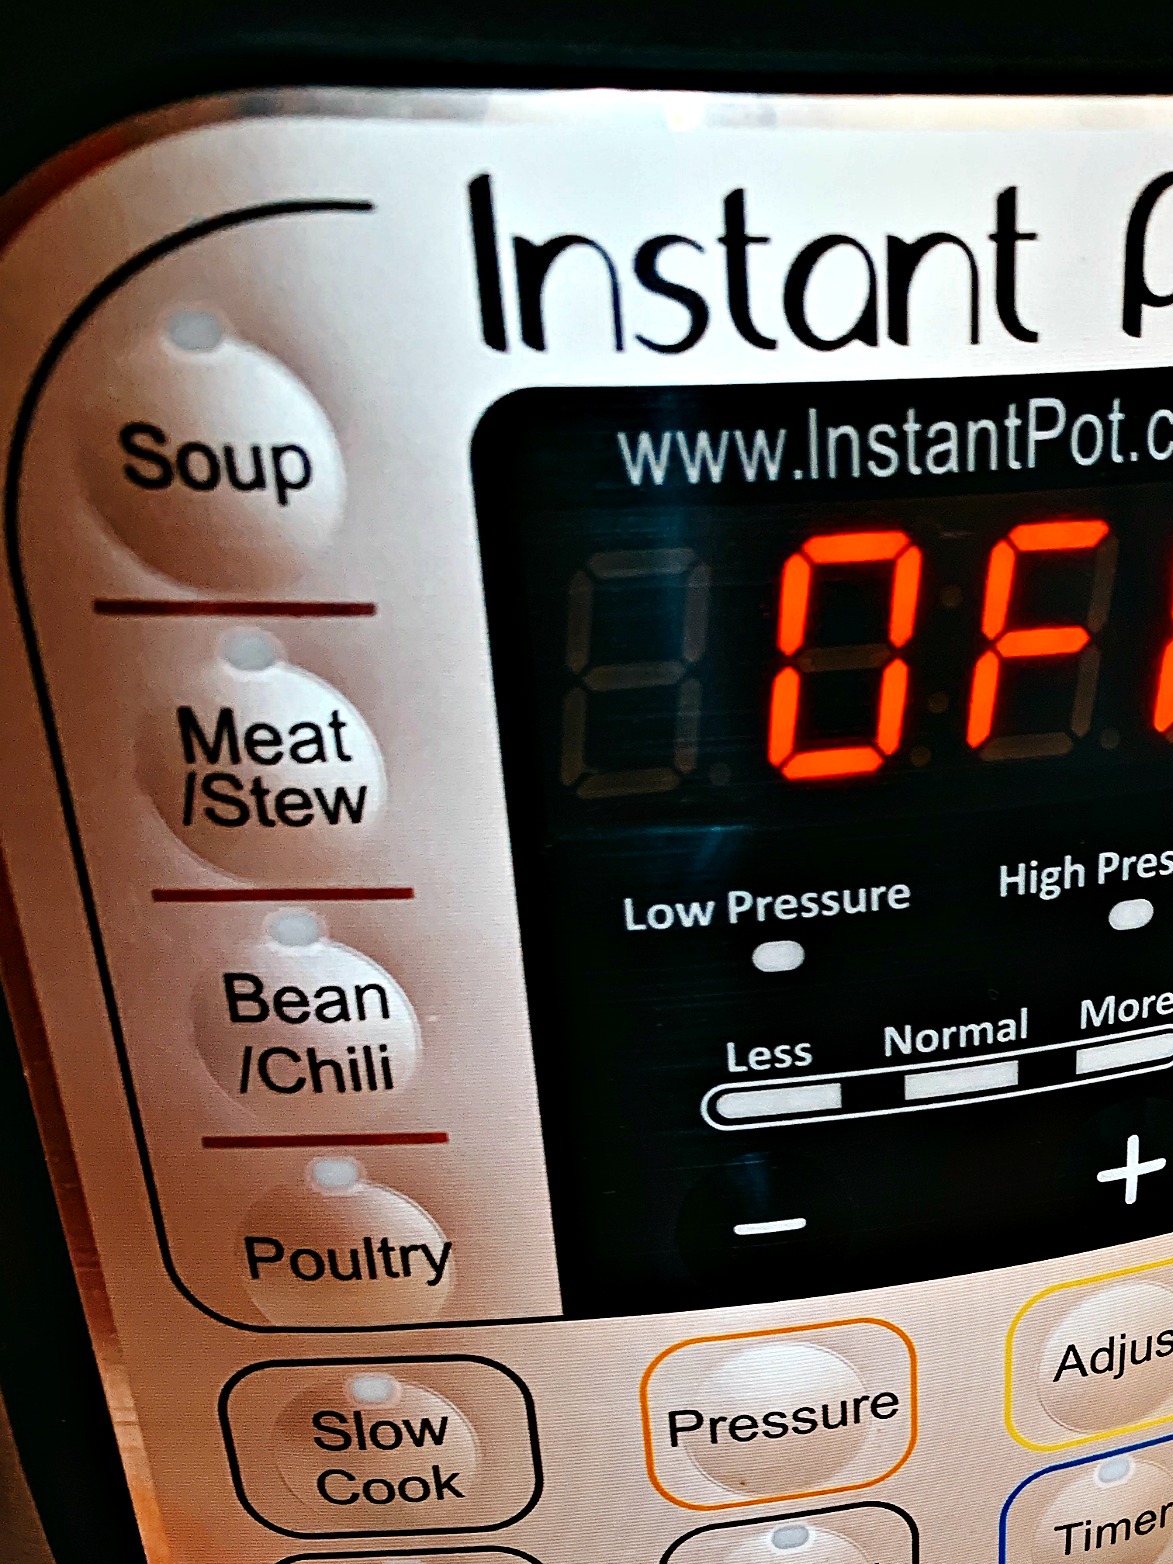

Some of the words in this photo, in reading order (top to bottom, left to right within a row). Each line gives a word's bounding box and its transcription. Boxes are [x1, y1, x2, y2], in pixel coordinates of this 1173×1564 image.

[467, 171, 1040, 354] Instant
[120, 422, 312, 506] Soup
[176, 705, 354, 766] Meat
[181, 772, 368, 828] /Stew
[999, 856, 1086, 901] High
[624, 896, 713, 932] Low
[727, 883, 913, 925] Pressure
[222, 972, 390, 1025] Bean
[726, 1038, 813, 1074] Less
[884, 1009, 1029, 1057] Normal
[239, 1044, 395, 1096] /Chili
[244, 1235, 452, 1286] Poultry
[312, 1409, 450, 1453] Slow
[669, 1385, 900, 1448] Pressure
[316, 1464, 465, 1508] Cook
[1053, 1496, 1173, 1559] Timer
